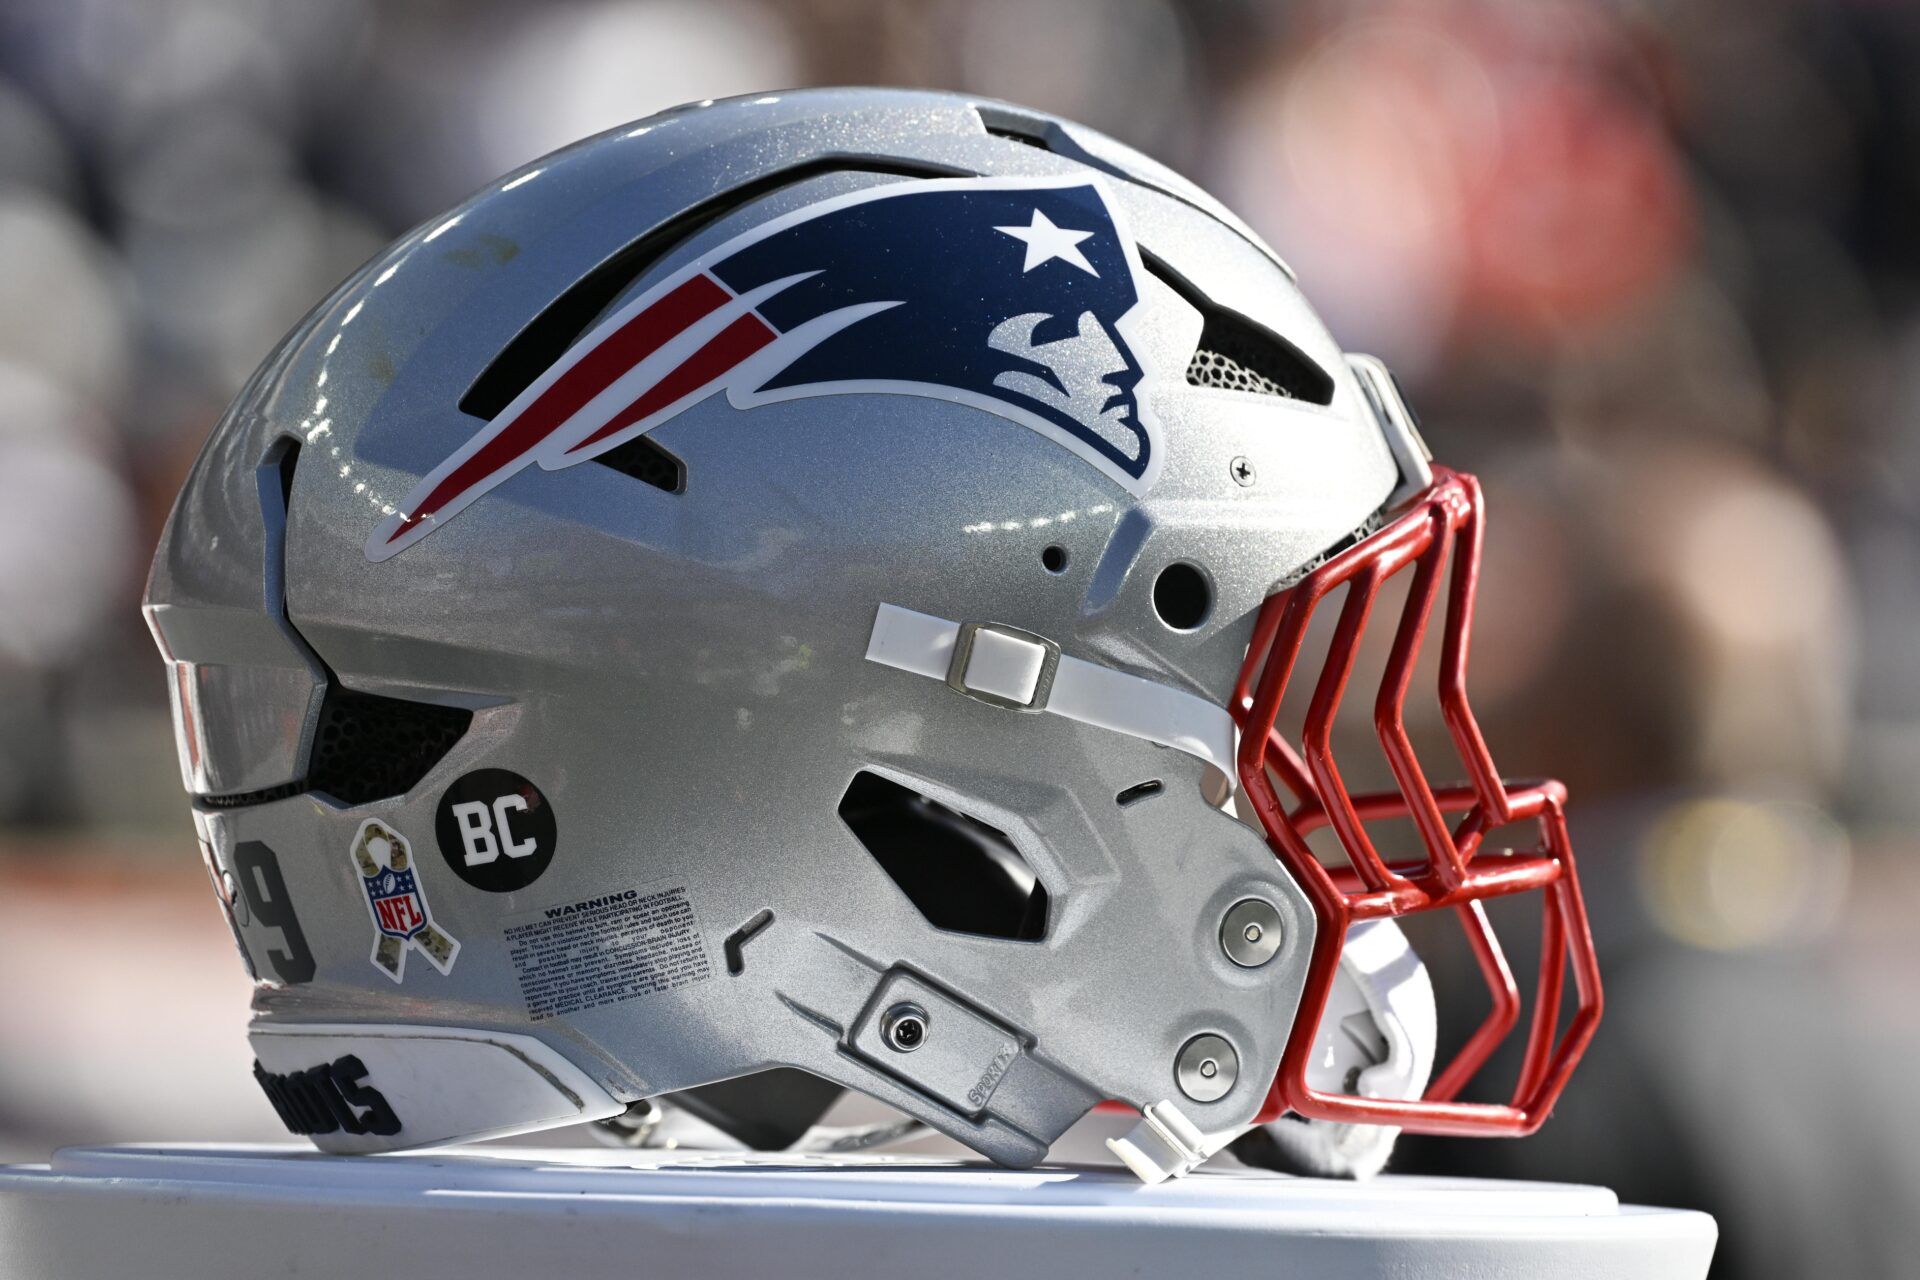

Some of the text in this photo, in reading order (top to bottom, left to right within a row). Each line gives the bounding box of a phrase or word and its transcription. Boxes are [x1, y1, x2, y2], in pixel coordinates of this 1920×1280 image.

[452, 794, 537, 867] BC
[233, 840, 317, 984] 9
[375, 896, 422, 932] NFL
[544, 889, 638, 919] WARNING
